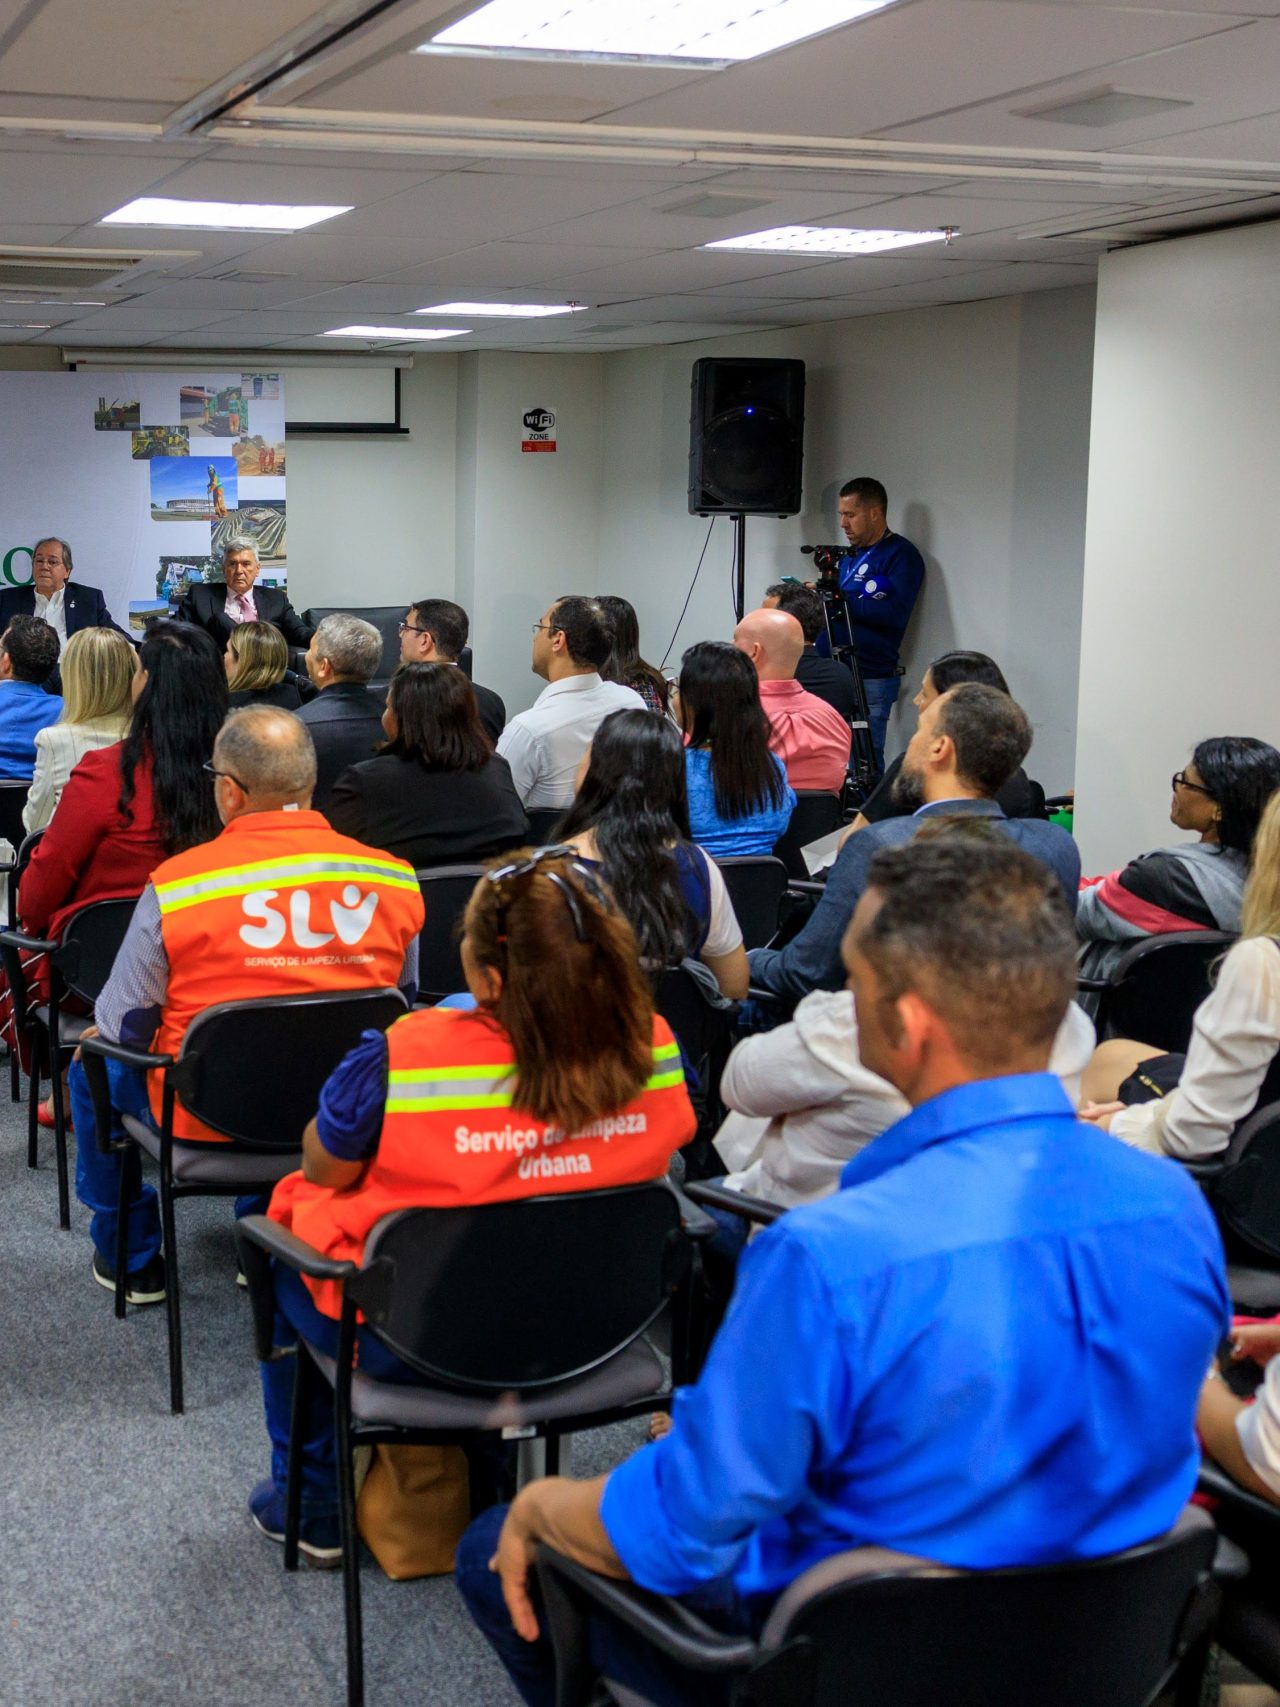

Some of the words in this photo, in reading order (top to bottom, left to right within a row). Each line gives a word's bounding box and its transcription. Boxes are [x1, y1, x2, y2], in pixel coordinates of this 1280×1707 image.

[528, 433, 549, 441] ZONE
[244, 956, 286, 968] SERVIÇO
[287, 956, 300, 966] DE
[301, 955, 342, 967] LIMPEZA
[454, 1124, 539, 1157] Serviço
[518, 1152, 593, 1180] Urbana
